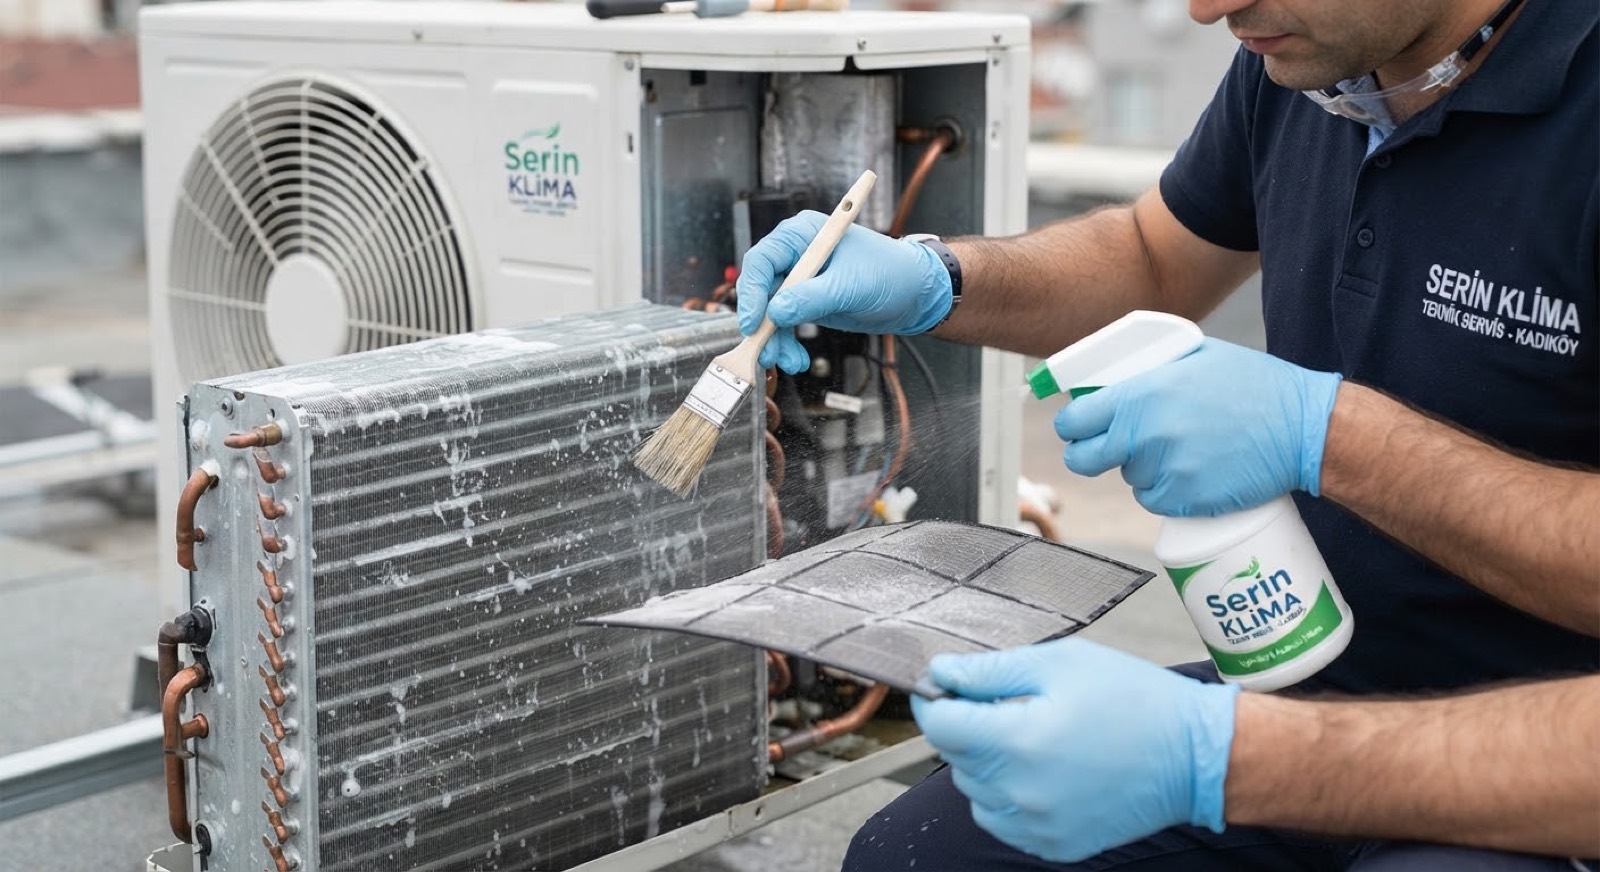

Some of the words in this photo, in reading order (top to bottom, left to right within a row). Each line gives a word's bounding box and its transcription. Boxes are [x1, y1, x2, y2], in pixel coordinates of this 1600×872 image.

[504, 141, 579, 175] Serin
[1426, 263, 1494, 312] SERİN
[1497, 286, 1581, 334] KLİMA
[1460, 313, 1505, 339] SERVİS
[1515, 327, 1580, 357] KADIKÖY
[1206, 569, 1292, 617] Serin
